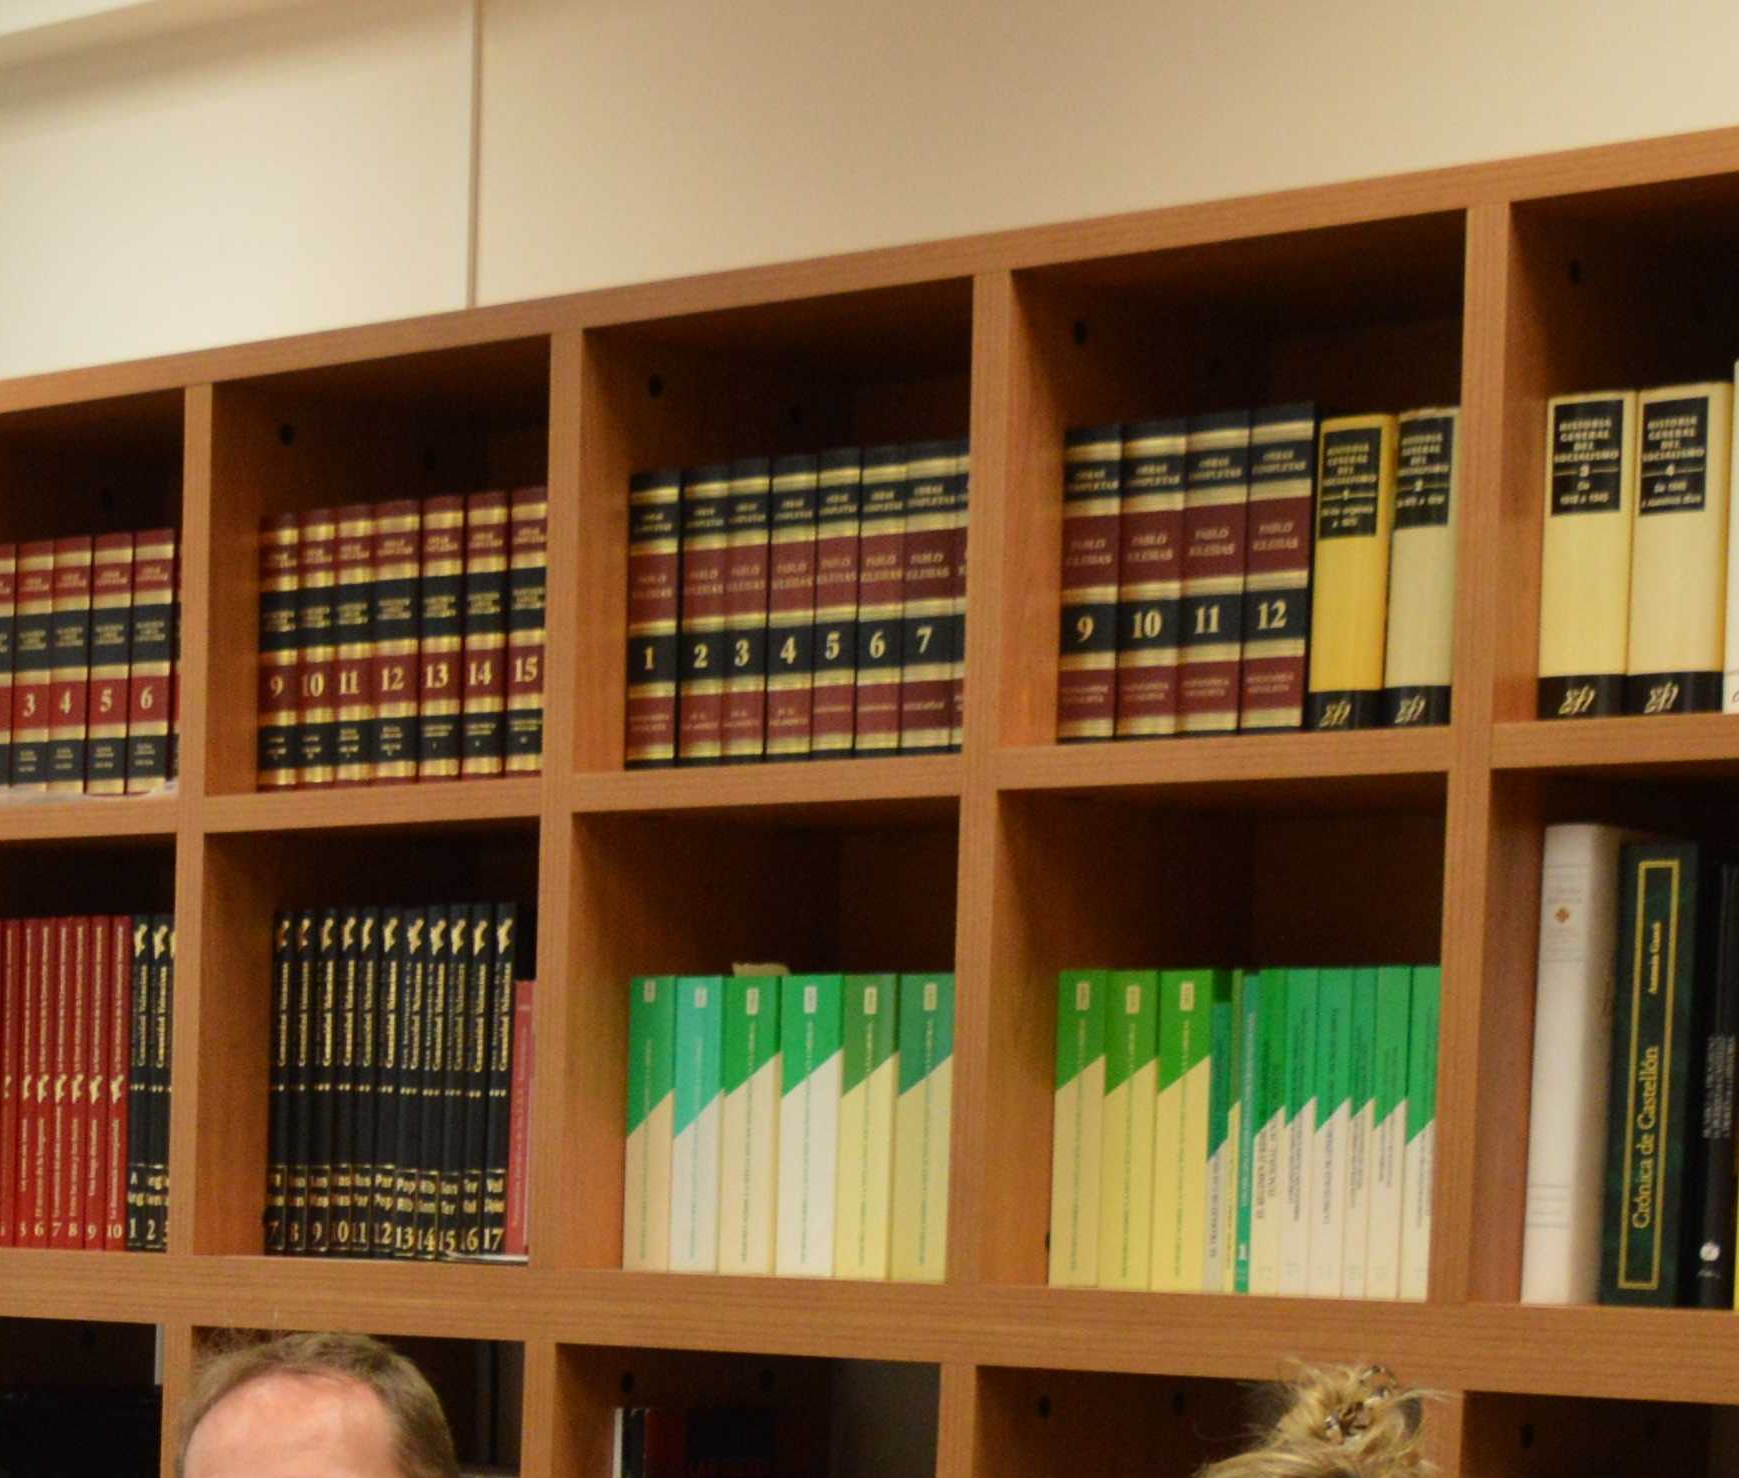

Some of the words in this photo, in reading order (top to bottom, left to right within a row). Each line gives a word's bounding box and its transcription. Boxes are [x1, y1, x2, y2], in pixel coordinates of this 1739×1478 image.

[1132, 609, 1162, 639] 10
[1194, 604, 1221, 635] 11
[1257, 600, 1287, 630] 12
[916, 625, 933, 653] 7
[1077, 616, 1094, 642] 9
[693, 644, 708, 668] 2
[734, 639, 750, 666] 3
[780, 636, 796, 664] 4
[826, 630, 840, 660] 5
[870, 631, 885, 658] 6
[515, 656, 538, 683] 15
[644, 647, 654, 669] 1
[302, 672, 324, 697] 10
[339, 670, 360, 694] 11
[382, 667, 404, 691] 12
[425, 662, 448, 688] 13
[469, 660, 492, 686] 14
[141, 686, 153, 709] 6
[271, 678, 283, 696] 9
[23, 693, 35, 717] 3
[60, 689, 71, 714] 4
[100, 688, 112, 713] 5
[1637, 1046, 1659, 1130] Castellón
[1640, 1134, 1653, 1156] de
[1632, 1157, 1652, 1229] Crónica
[35, 1223, 43, 1236] 6
[52, 1223, 61, 1237] 7
[69, 1223, 77, 1236] 8
[87, 1224, 96, 1239] 9
[107, 1224, 122, 1238] 10
[129, 1218, 136, 1239] 1
[147, 1220, 156, 1240] 2
[313, 1221, 322, 1243] 9
[396, 1227, 414, 1249] 13
[418, 1228, 435, 1250] 14
[483, 1227, 503, 1250] 17
